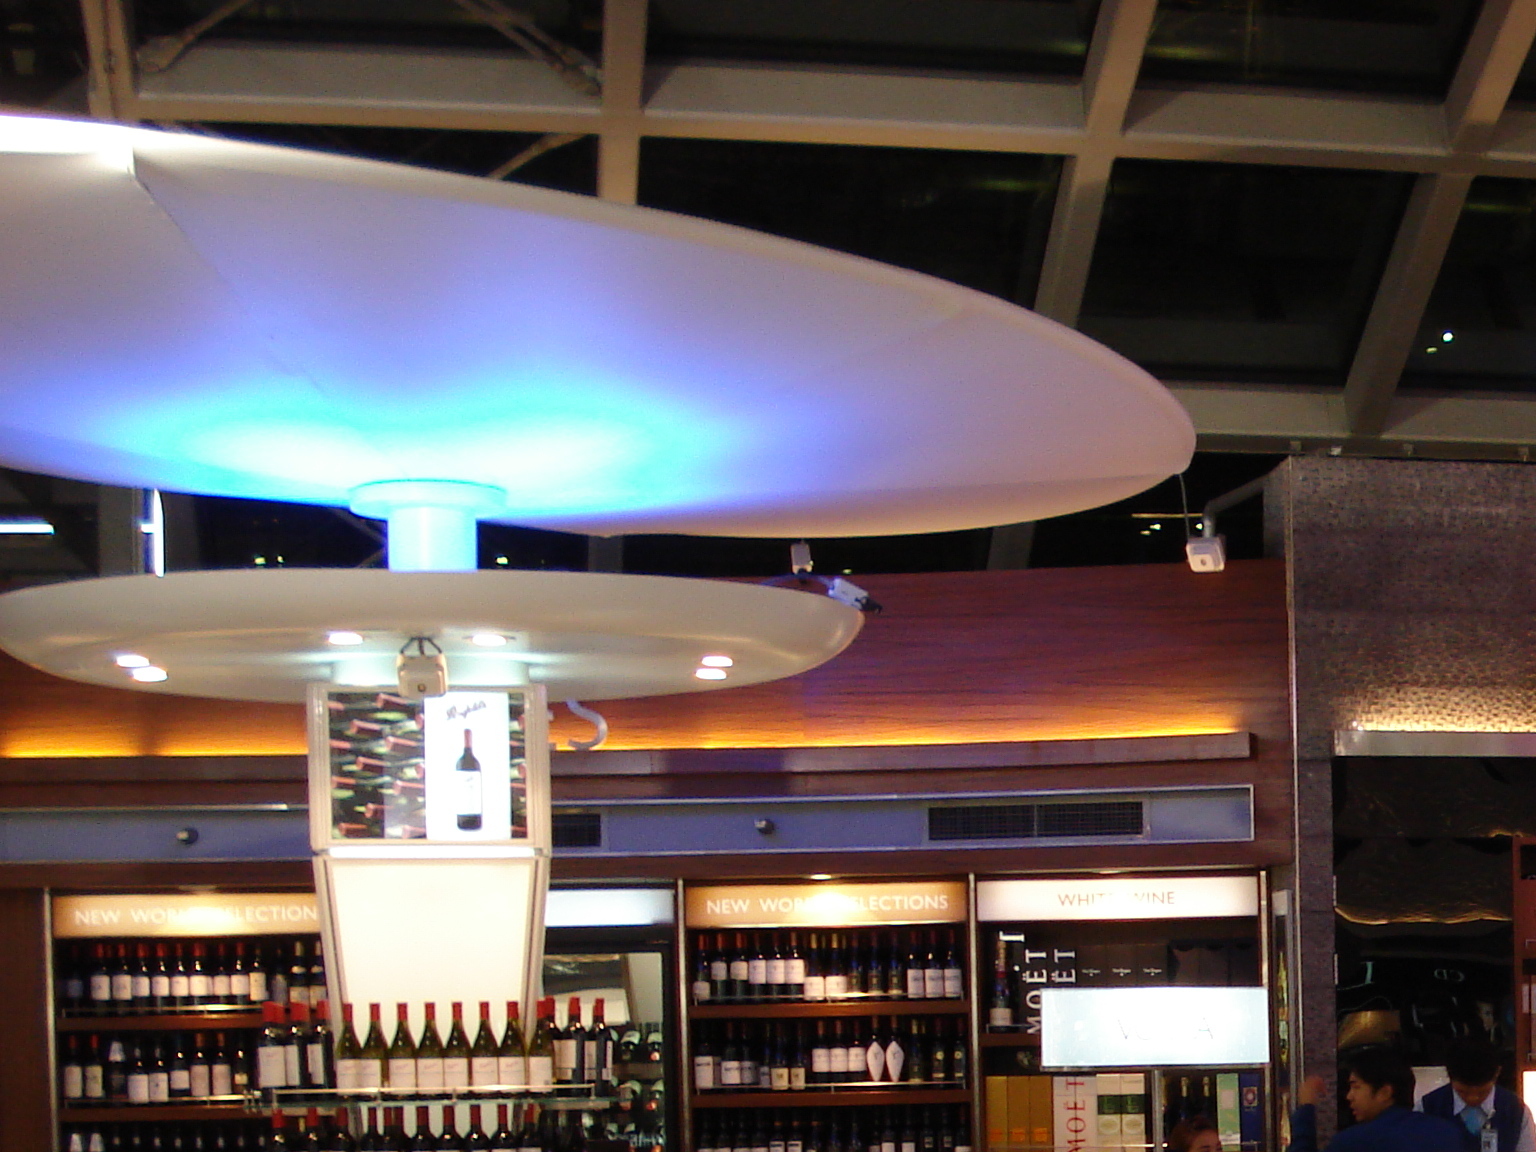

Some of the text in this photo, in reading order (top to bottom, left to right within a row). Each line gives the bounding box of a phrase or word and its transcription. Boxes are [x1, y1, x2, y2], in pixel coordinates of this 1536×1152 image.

[549, 699, 608, 750] S
[707, 898, 750, 915] NEW
[1057, 892, 1118, 907] WHIT
[74, 909, 121, 925] NEW
